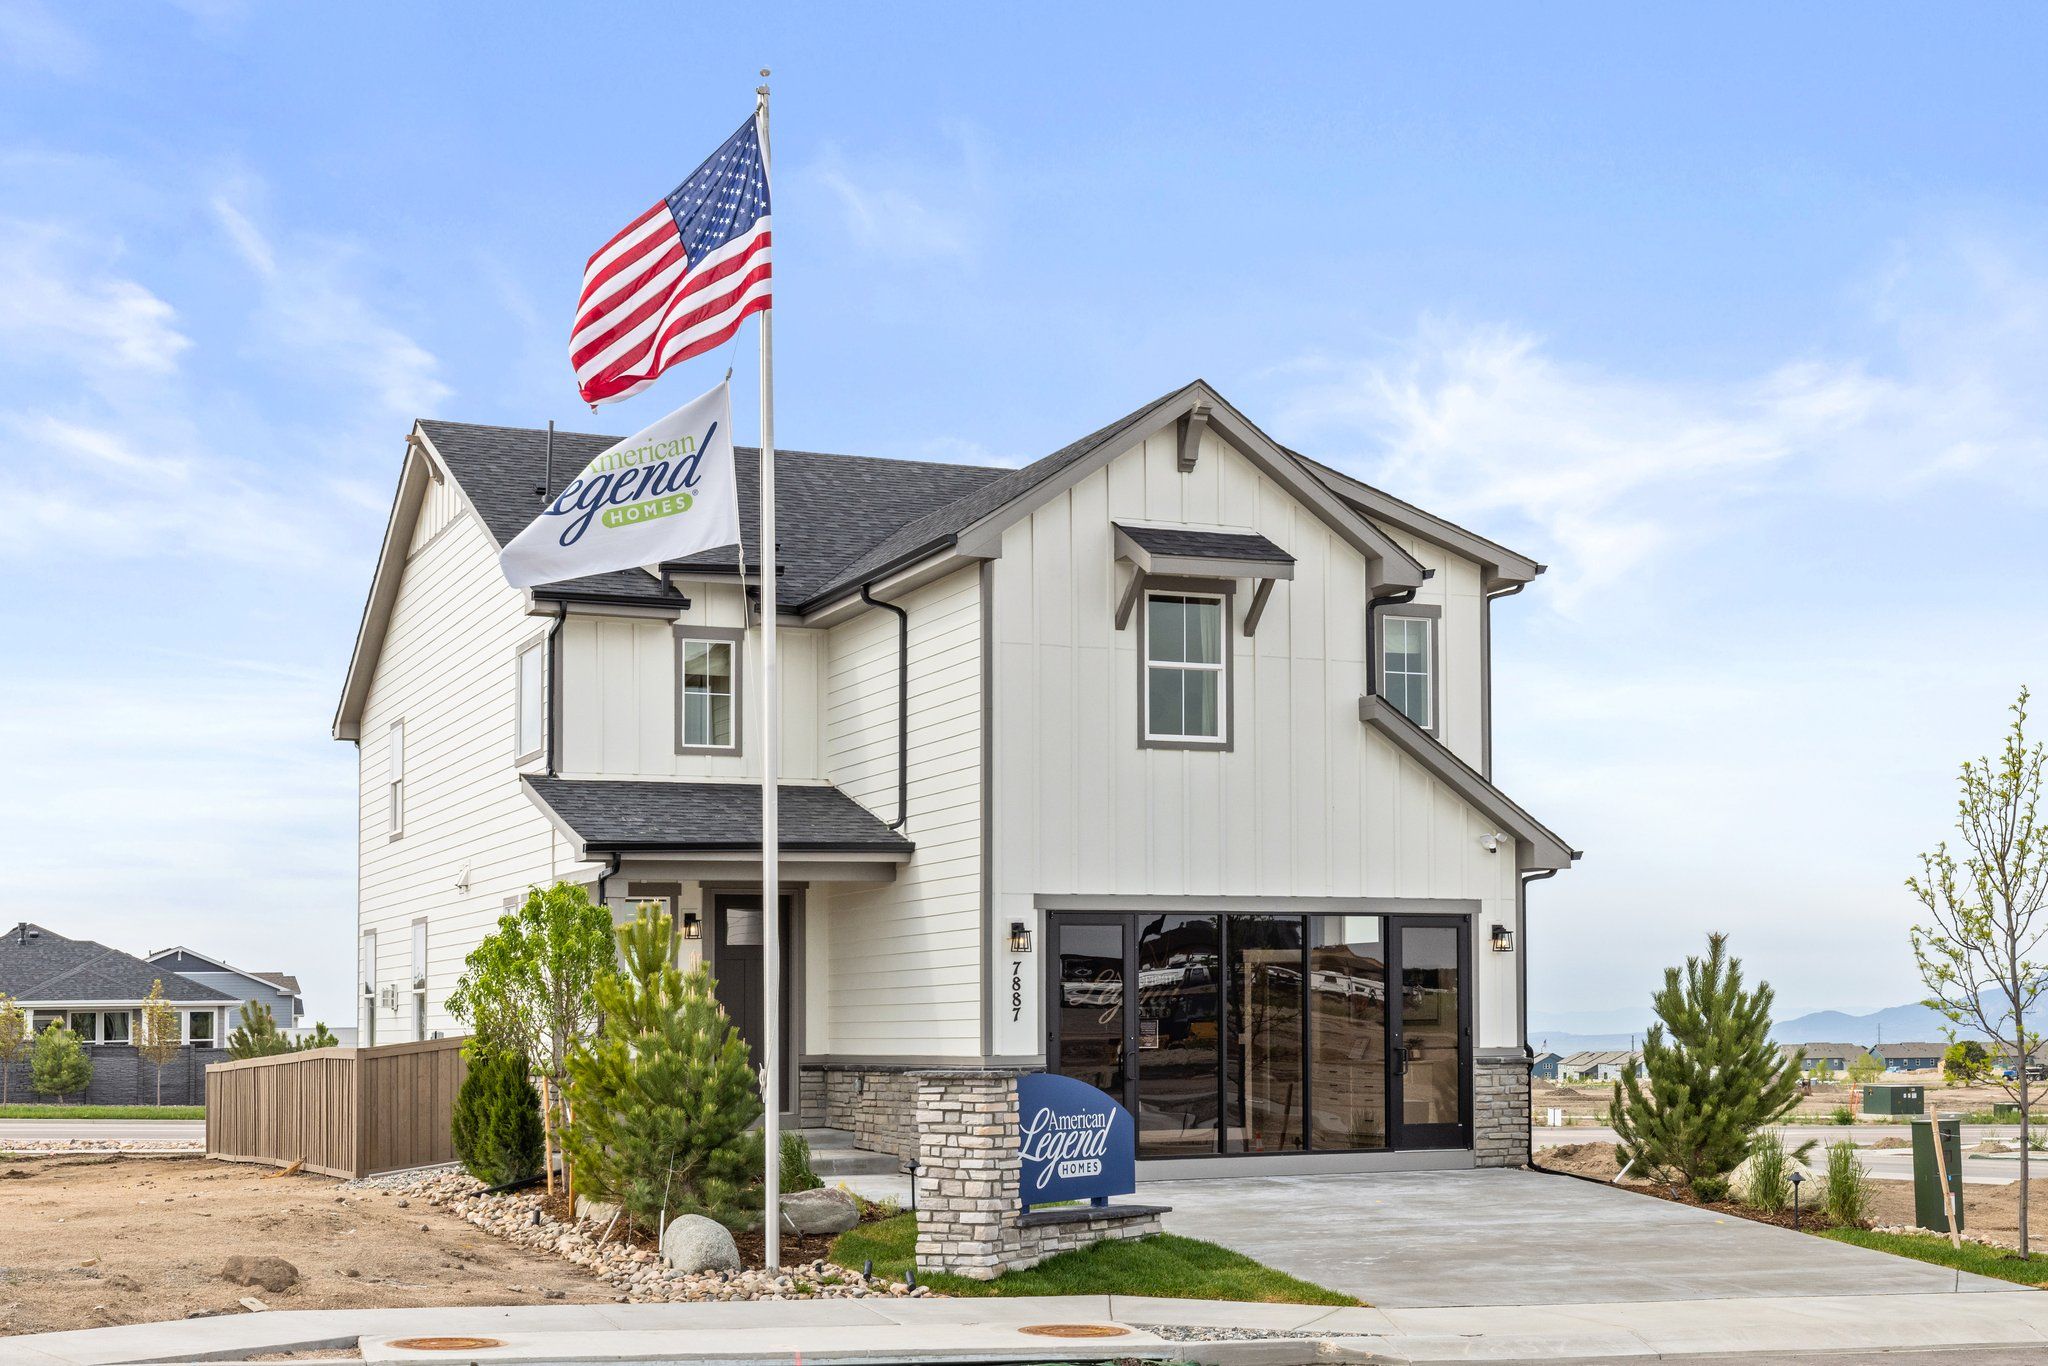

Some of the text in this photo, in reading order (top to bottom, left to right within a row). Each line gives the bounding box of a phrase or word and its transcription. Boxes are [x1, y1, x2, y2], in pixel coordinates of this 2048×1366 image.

[543, 420, 718, 546] egend
[609, 496, 686, 525] HOMES
[1011, 960, 1022, 1023] 7887
[1048, 1108, 1106, 1131] American
[1017, 1107, 1117, 1189] Legend
[1062, 1161, 1099, 1175] HOMES
